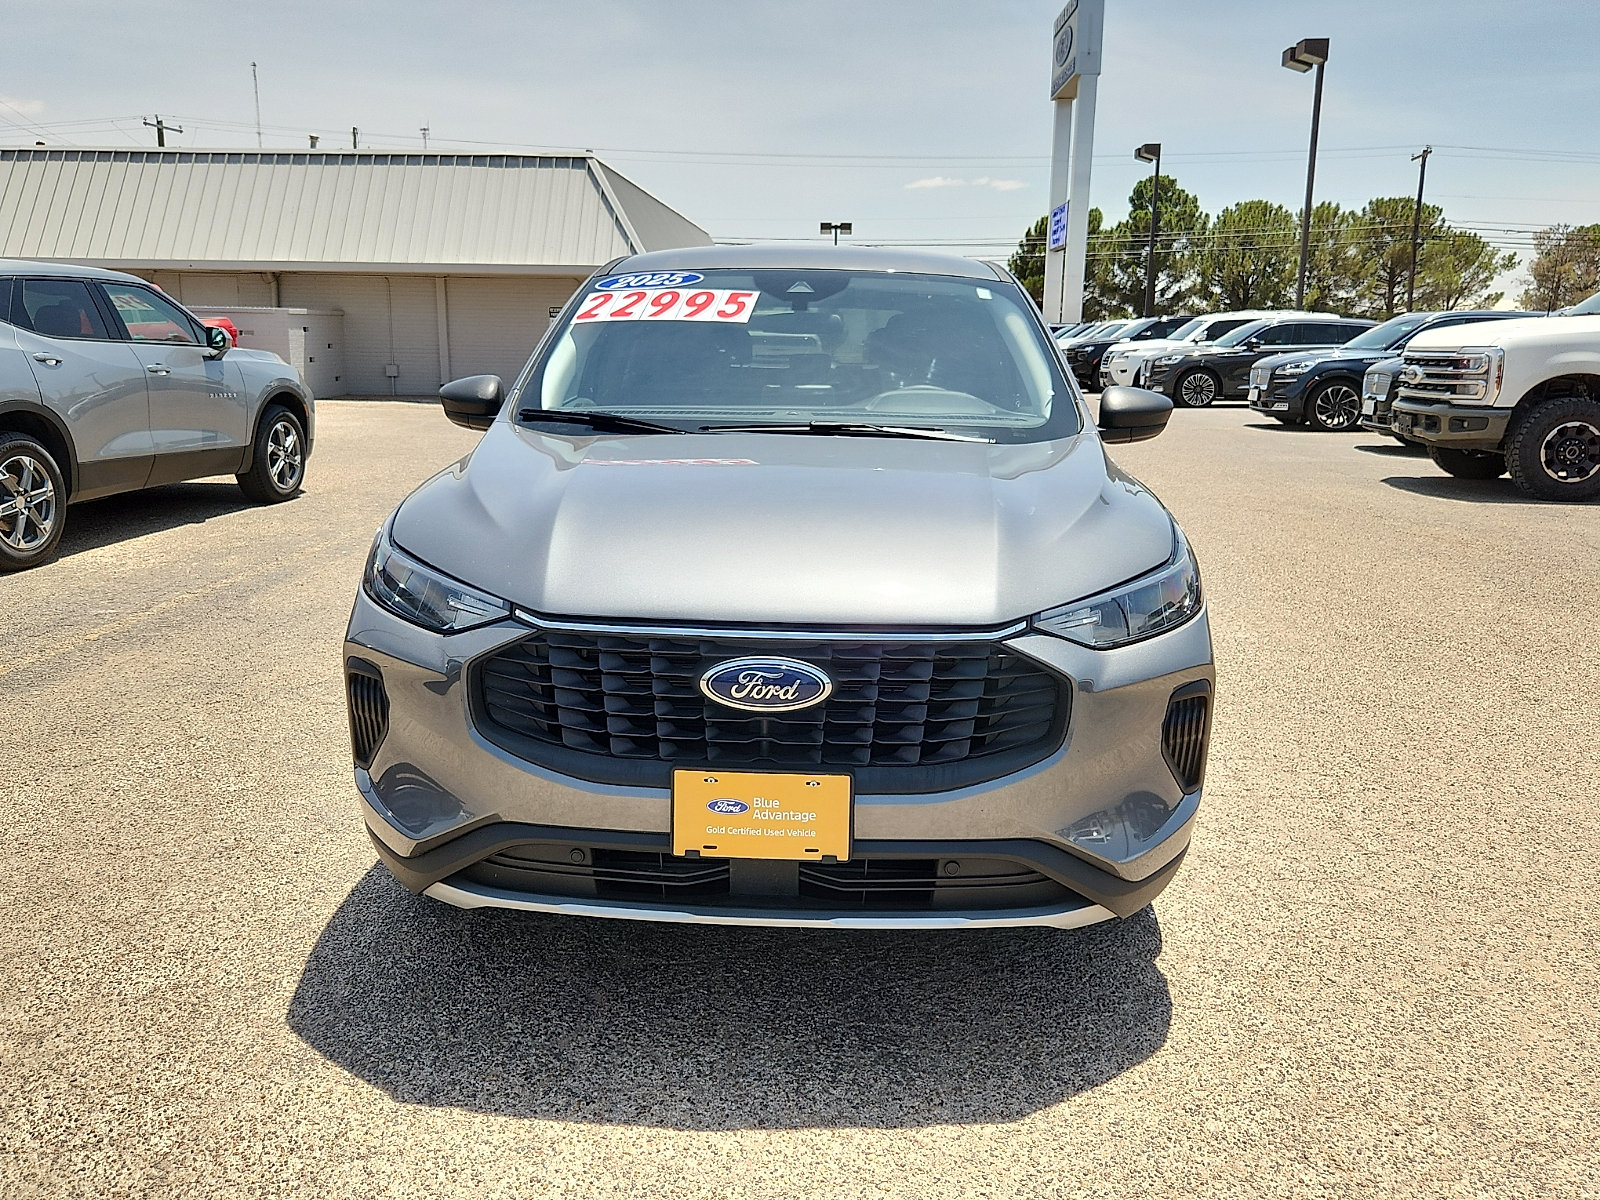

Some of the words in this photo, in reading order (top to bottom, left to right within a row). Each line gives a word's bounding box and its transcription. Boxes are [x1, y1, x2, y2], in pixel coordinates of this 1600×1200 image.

[614, 273, 684, 288] 2025
[576, 290, 754, 320] 22995
[730, 670, 801, 700] Ford
[715, 801, 741, 812] Ford
[753, 797, 780, 808] Blue
[753, 809, 817, 822] Advantage
[706, 825, 726, 835] Gold
[727, 826, 762, 836] Certified
[764, 828, 785, 837] Used
[787, 829, 816, 837] Vehicle
